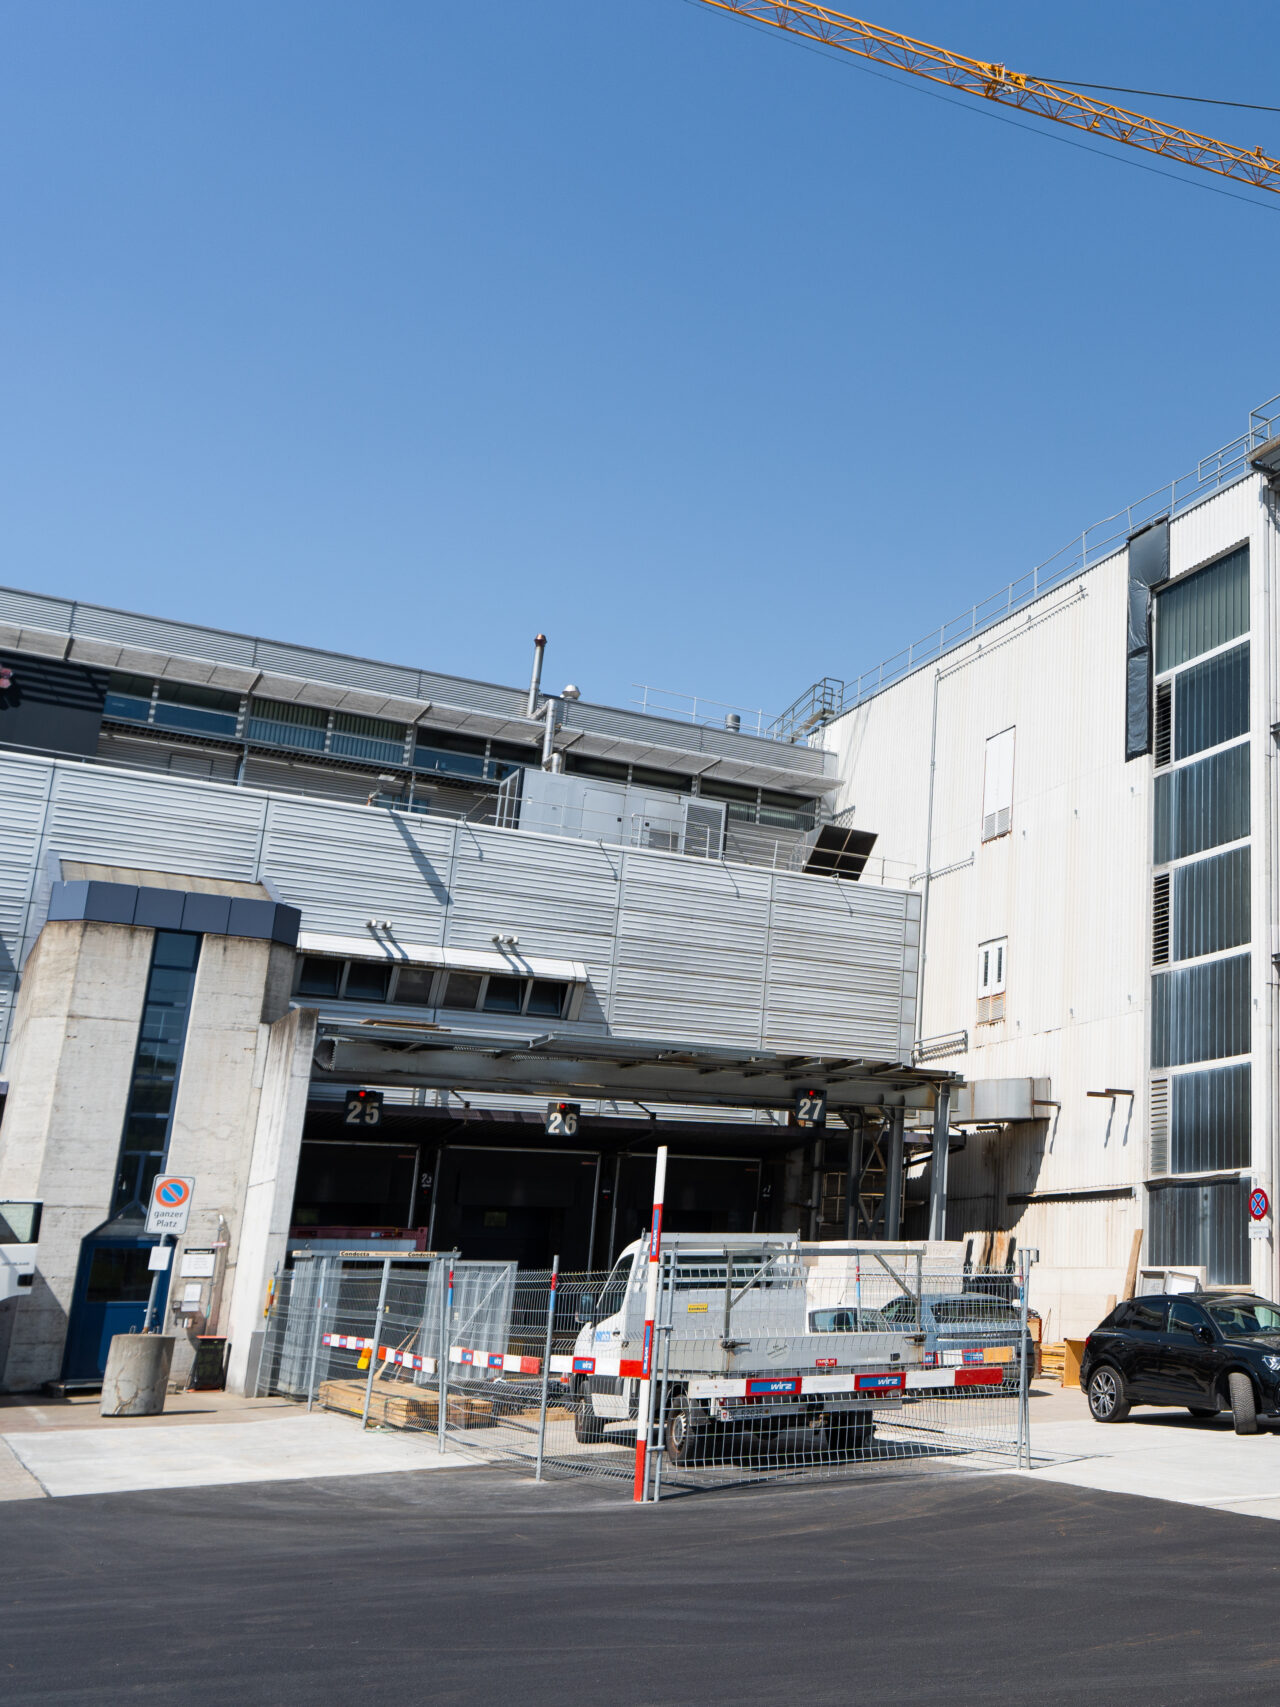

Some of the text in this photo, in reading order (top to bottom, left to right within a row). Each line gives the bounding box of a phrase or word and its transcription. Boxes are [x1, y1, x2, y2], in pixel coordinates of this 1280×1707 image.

[346, 1101, 380, 1124] 25
[797, 1098, 823, 1120] 27
[548, 1112, 577, 1134] 26
[770, 1381, 793, 1390] wirz
[877, 1377, 898, 1385] wirz
